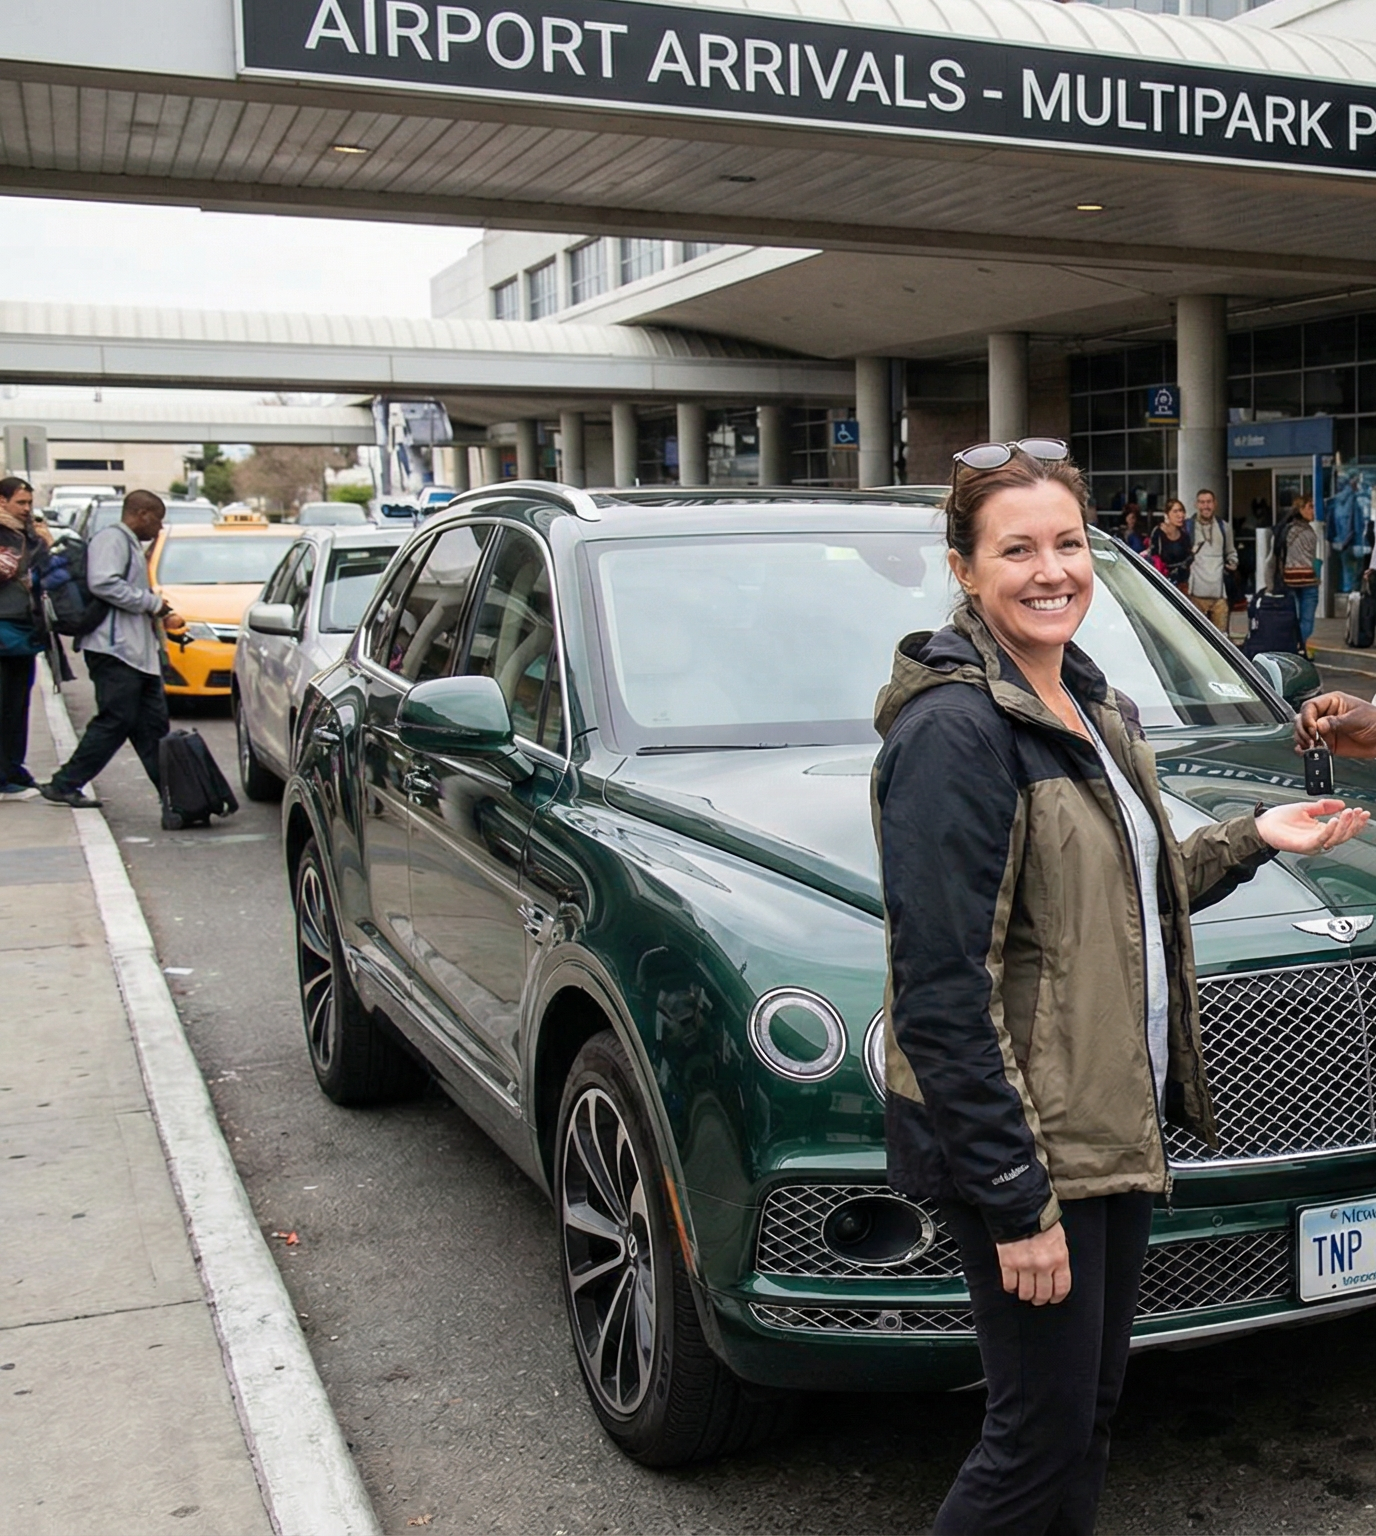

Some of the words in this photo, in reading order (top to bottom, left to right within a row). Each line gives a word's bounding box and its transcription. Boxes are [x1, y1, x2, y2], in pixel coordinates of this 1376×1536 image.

[304, 0, 628, 79] AIRPORT
[648, 30, 967, 113] ARRIVALS
[983, 89, 1003, 99] -
[1022, 68, 1333, 150] MULTIPARK
[1312, 1229, 1363, 1276] TNP
